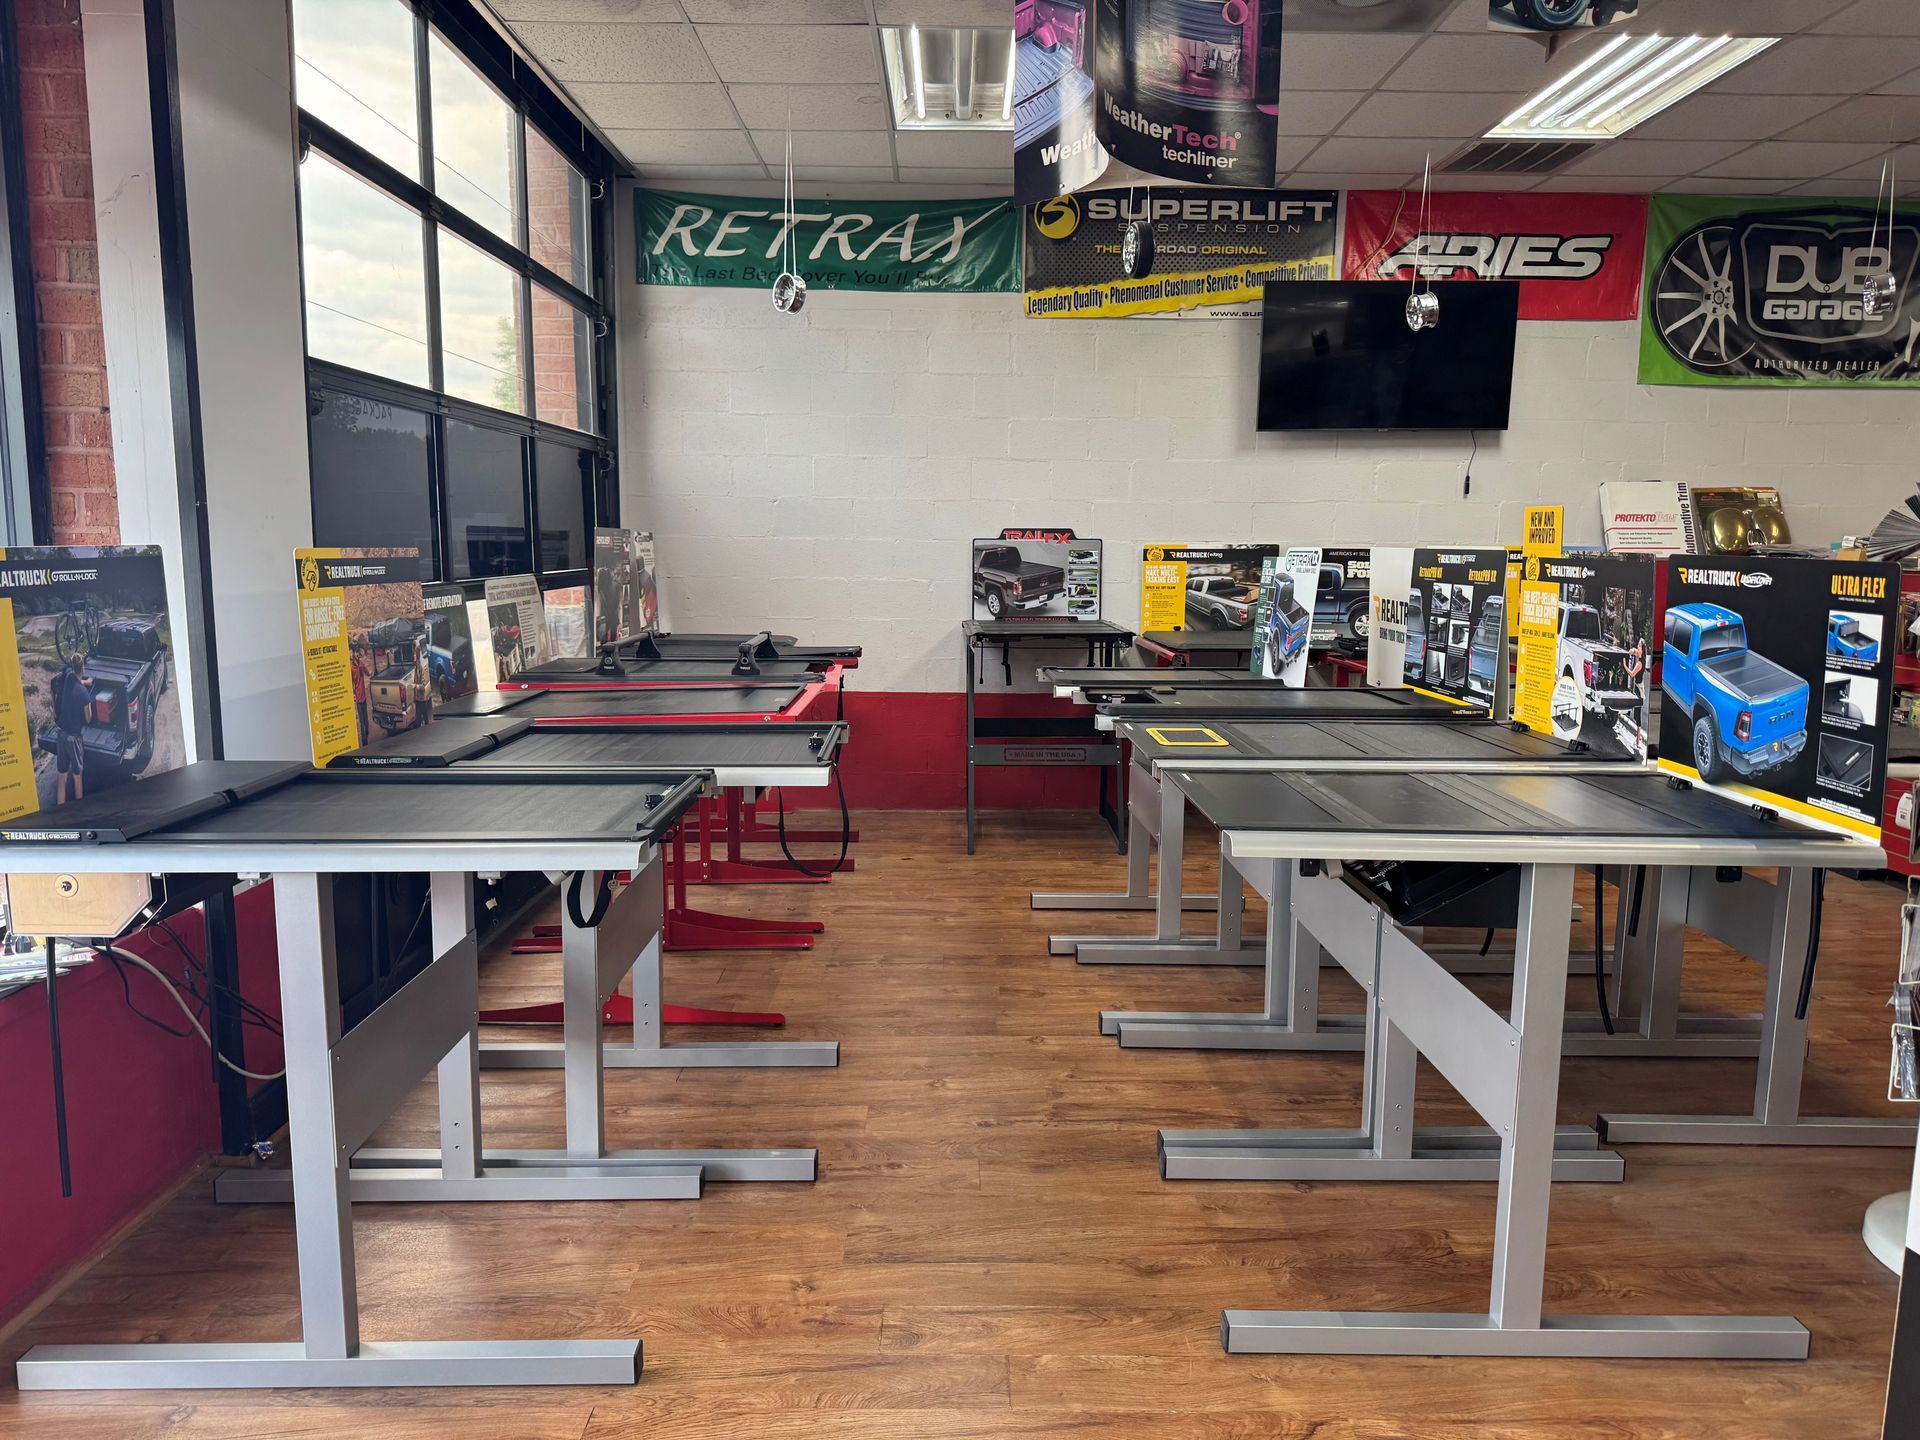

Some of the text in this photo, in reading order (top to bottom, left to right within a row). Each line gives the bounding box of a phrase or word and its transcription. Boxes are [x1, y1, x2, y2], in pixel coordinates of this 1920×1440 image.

[1162, 145, 1235, 169] techliner
[1088, 199, 1333, 222] SUPERLIFT
[652, 200, 1009, 263] RETRAX
[1118, 223, 1301, 233] SSPENSION
[1095, 244, 1121, 254] THE
[1201, 245, 1267, 255] ORIGINAL
[1377, 234, 1611, 279] ARIES
[694, 266, 735, 281] Last
[1766, 245, 1889, 294] DUB
[1028, 294, 1072, 315] Legendary
[1074, 289, 1104, 311] Quality
[1110, 279, 1163, 304] Phenomenal
[1164, 275, 1205, 299] Customer
[1206, 273, 1239, 293] Service
[1754, 358, 1880, 371] AUTHORIZED DEALER
[1530, 511, 1555, 527] NEW AND
[1614, 513, 1656, 522] PROTEKTO
[1677, 482, 1697, 555] Automotive Trim
[1003, 530, 1072, 545] TRAILFX
[1528, 527, 1556, 544] IMPROVED
[1176, 551, 1207, 559] REALTRUCK
[331, 565, 361, 579] REALTRUCK
[1551, 565, 1579, 578] REALTRUCK
[1688, 569, 1737, 587] REALTRUCK
[1831, 575, 1886, 599] ULTRA FLEX
[11, 831, 46, 841] REALTRUCK
